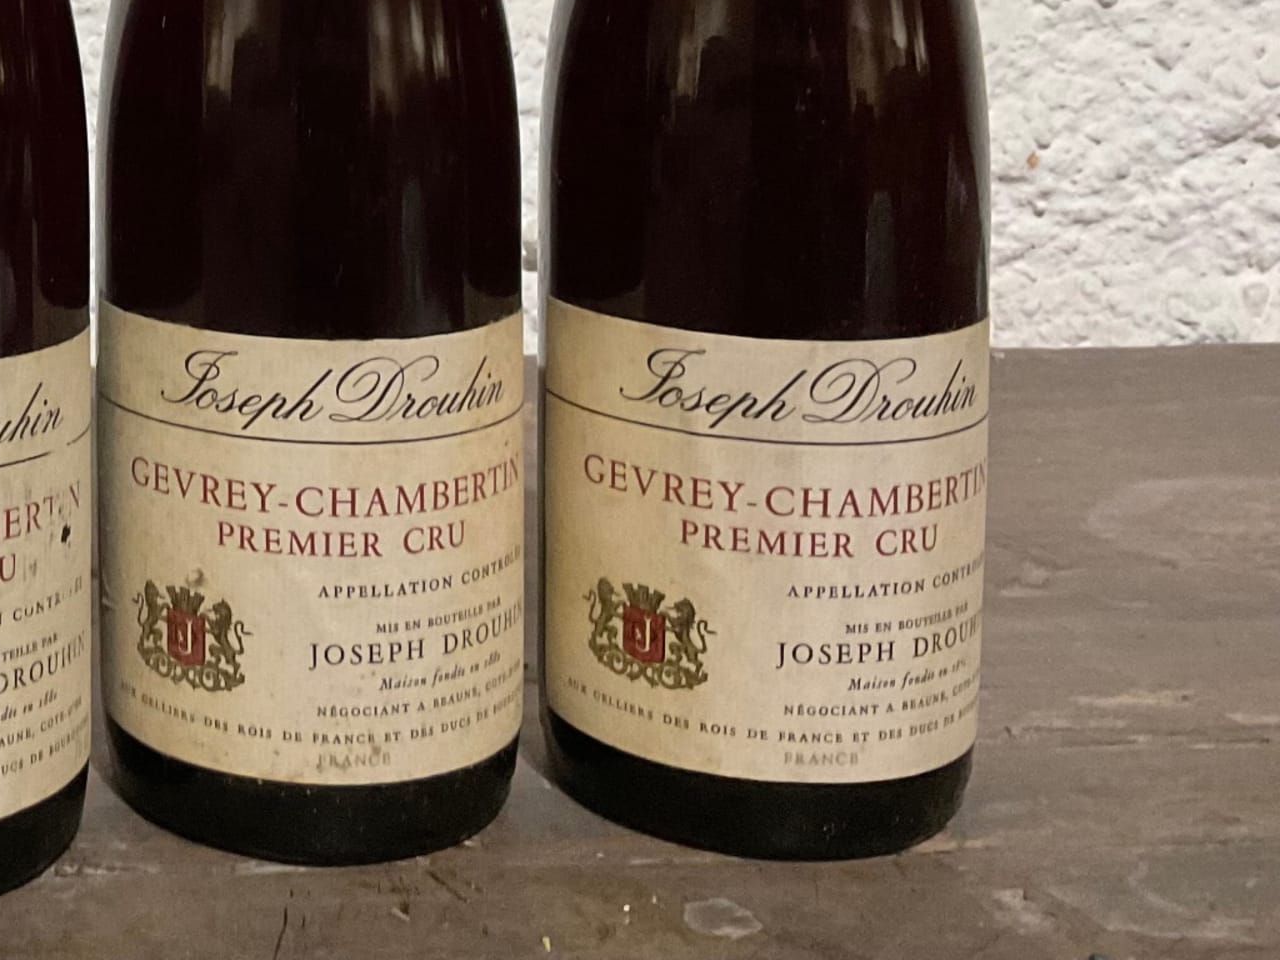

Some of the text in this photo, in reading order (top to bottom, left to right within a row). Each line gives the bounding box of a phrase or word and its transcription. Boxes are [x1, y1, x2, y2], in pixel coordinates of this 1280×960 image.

[161, 349, 506, 431] Joseph Drouhin
[619, 347, 978, 429] Joseph Drouhin
[130, 451, 521, 518] GEVREY-CHAMBERTIN
[217, 519, 467, 558] PREMIER CRU
[680, 519, 939, 558] PREMIER CRU
[317, 574, 453, 599] APPELLATION
[787, 578, 925, 600] APPELLATION
[375, 623, 399, 634] MIS
[404, 618, 421, 632] EN
[427, 604, 484, 628] BOUTEILLE
[845, 623, 869, 635] MIS
[874, 620, 892, 633] EN
[308, 637, 425, 671] JOSEPH
[775, 640, 896, 669] JOSEPH
[378, 674, 427, 692] Maison
[847, 675, 896, 692] Maison
[204, 715, 229, 733] DES
[237, 723, 273, 740] ROIS
[282, 730, 303, 743] DE
[312, 732, 376, 746] FRANCE
[384, 730, 402, 744] ET
[410, 725, 435, 740] DES
[440, 714, 471, 734] DUCS
[662, 713, 690, 730] DES
[699, 722, 737, 738] ROIS
[746, 728, 768, 741] DE
[778, 730, 844, 744] FRANCE
[852, 730, 870, 743] ET
[878, 727, 903, 741] DES
[909, 719, 940, 737] DUCS
[30, 749, 44, 765] DE
[783, 750, 860, 766] FRANCE
